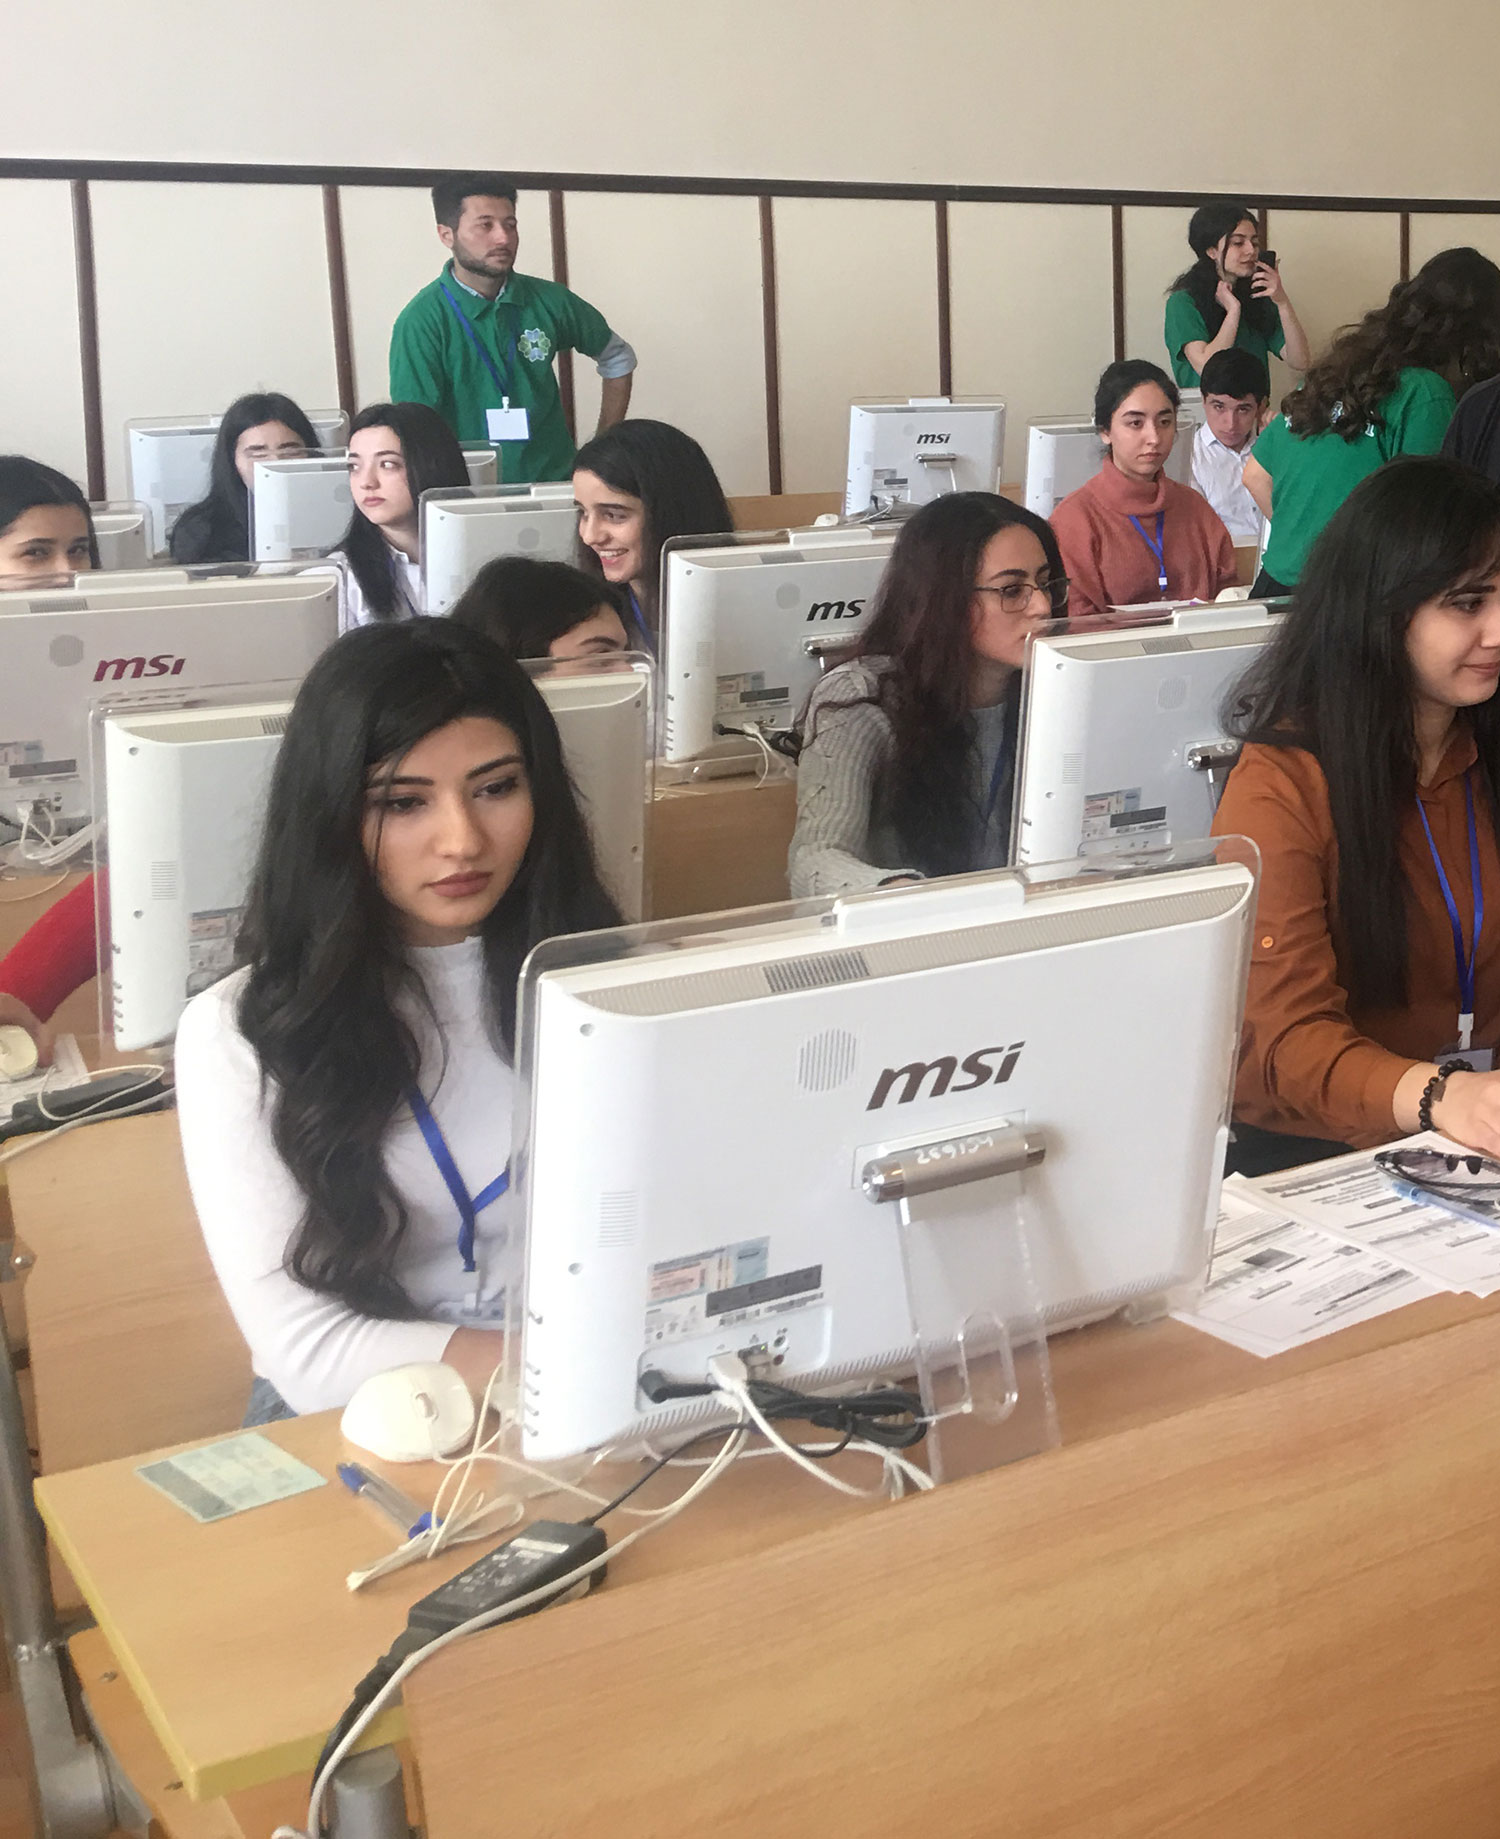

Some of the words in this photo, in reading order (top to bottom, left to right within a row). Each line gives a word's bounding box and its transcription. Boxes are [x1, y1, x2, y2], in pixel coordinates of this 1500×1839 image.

[917, 433, 951, 444] msi
[93, 655, 187, 682] msi
[865, 1041, 1026, 1111] msi
